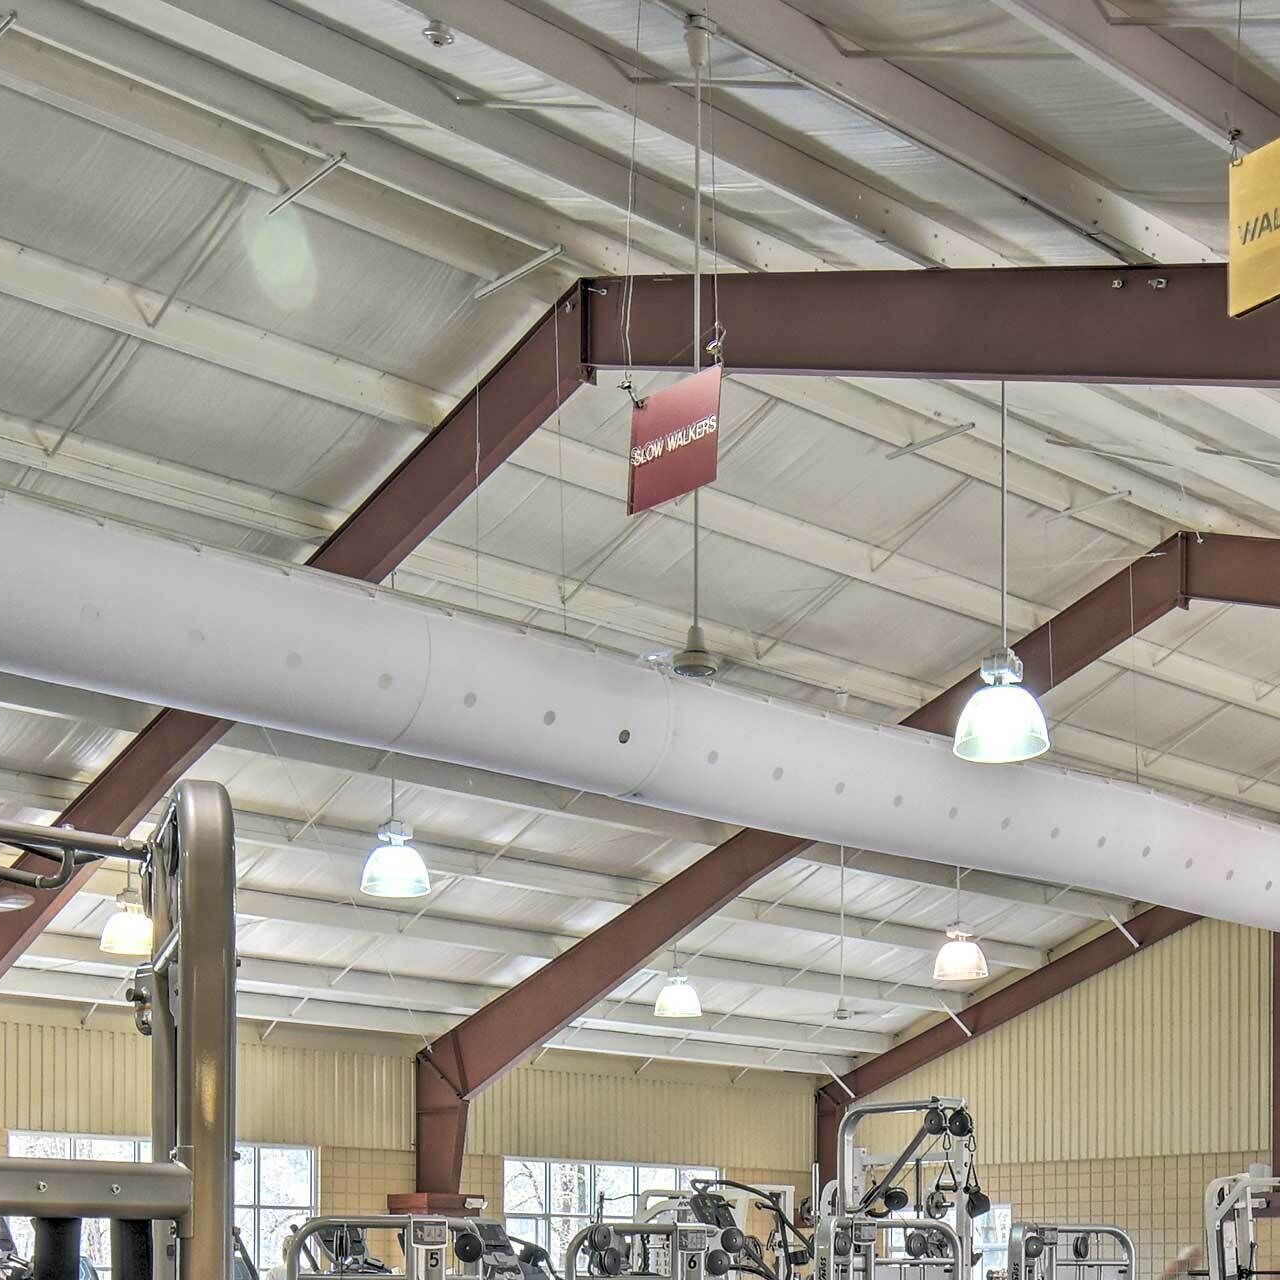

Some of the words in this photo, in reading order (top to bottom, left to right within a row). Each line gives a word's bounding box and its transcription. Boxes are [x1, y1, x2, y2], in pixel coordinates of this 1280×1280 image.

[631, 439, 665, 467] SLOW
[666, 416, 717, 452] WALKERS
[430, 1252, 439, 1267] 5
[688, 1255, 697, 1269] 6
